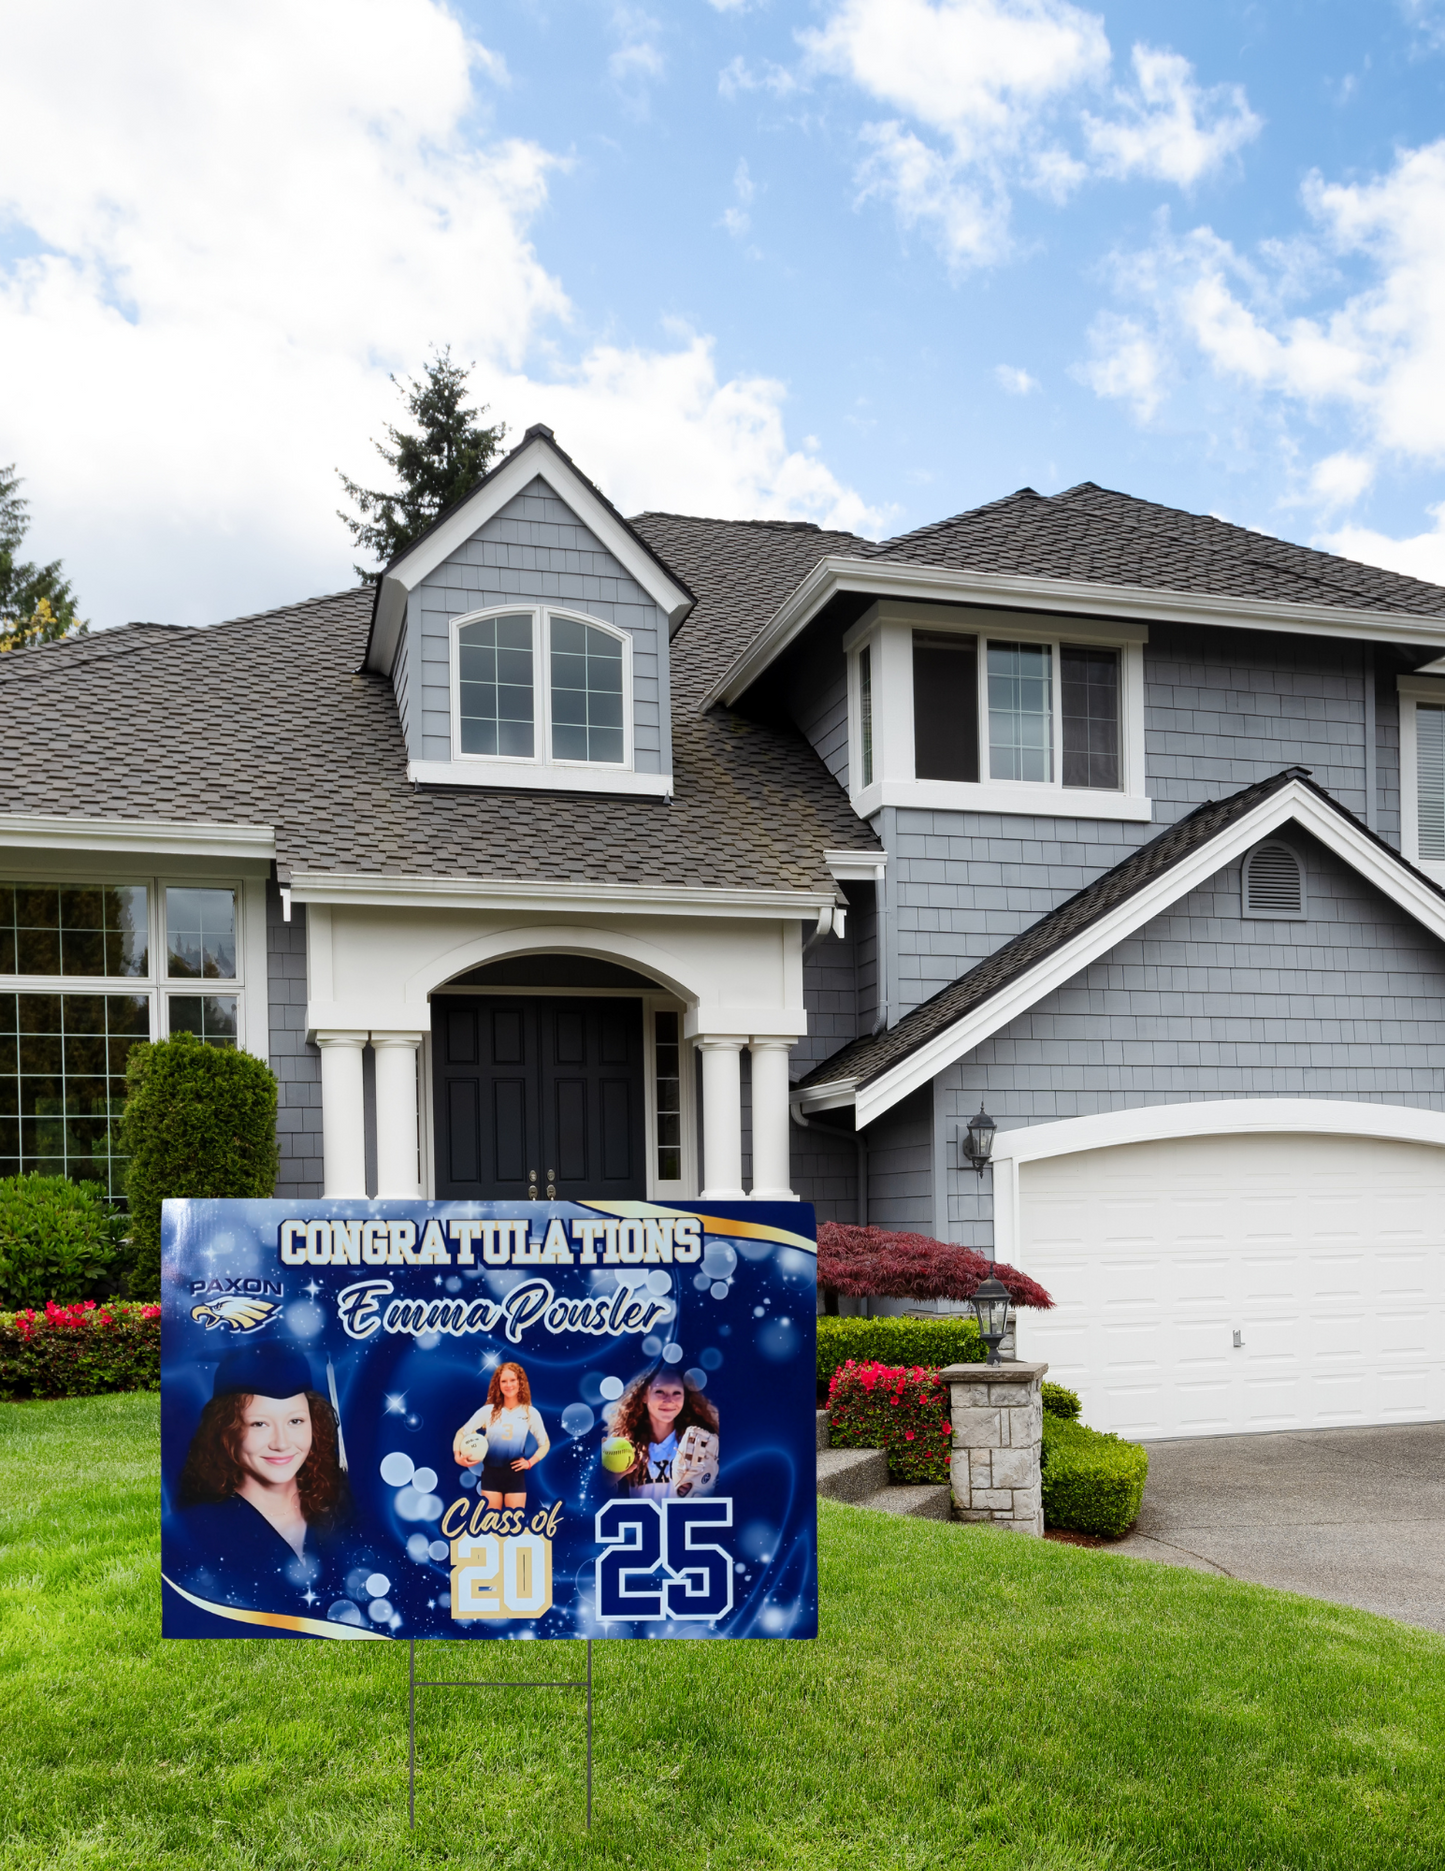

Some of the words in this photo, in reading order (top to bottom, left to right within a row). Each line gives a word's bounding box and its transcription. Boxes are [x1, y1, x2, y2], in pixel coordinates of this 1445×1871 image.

[279, 1218, 703, 1267] CONGRATULATIONS
[190, 1278, 284, 1298] PAXON
[339, 1280, 500, 1339] Emma
[501, 1424, 514, 1441] 3
[441, 1497, 525, 1538] Class
[531, 1500, 564, 1538] of
[450, 1533, 553, 1619] 20
[595, 1497, 733, 1621] 25
